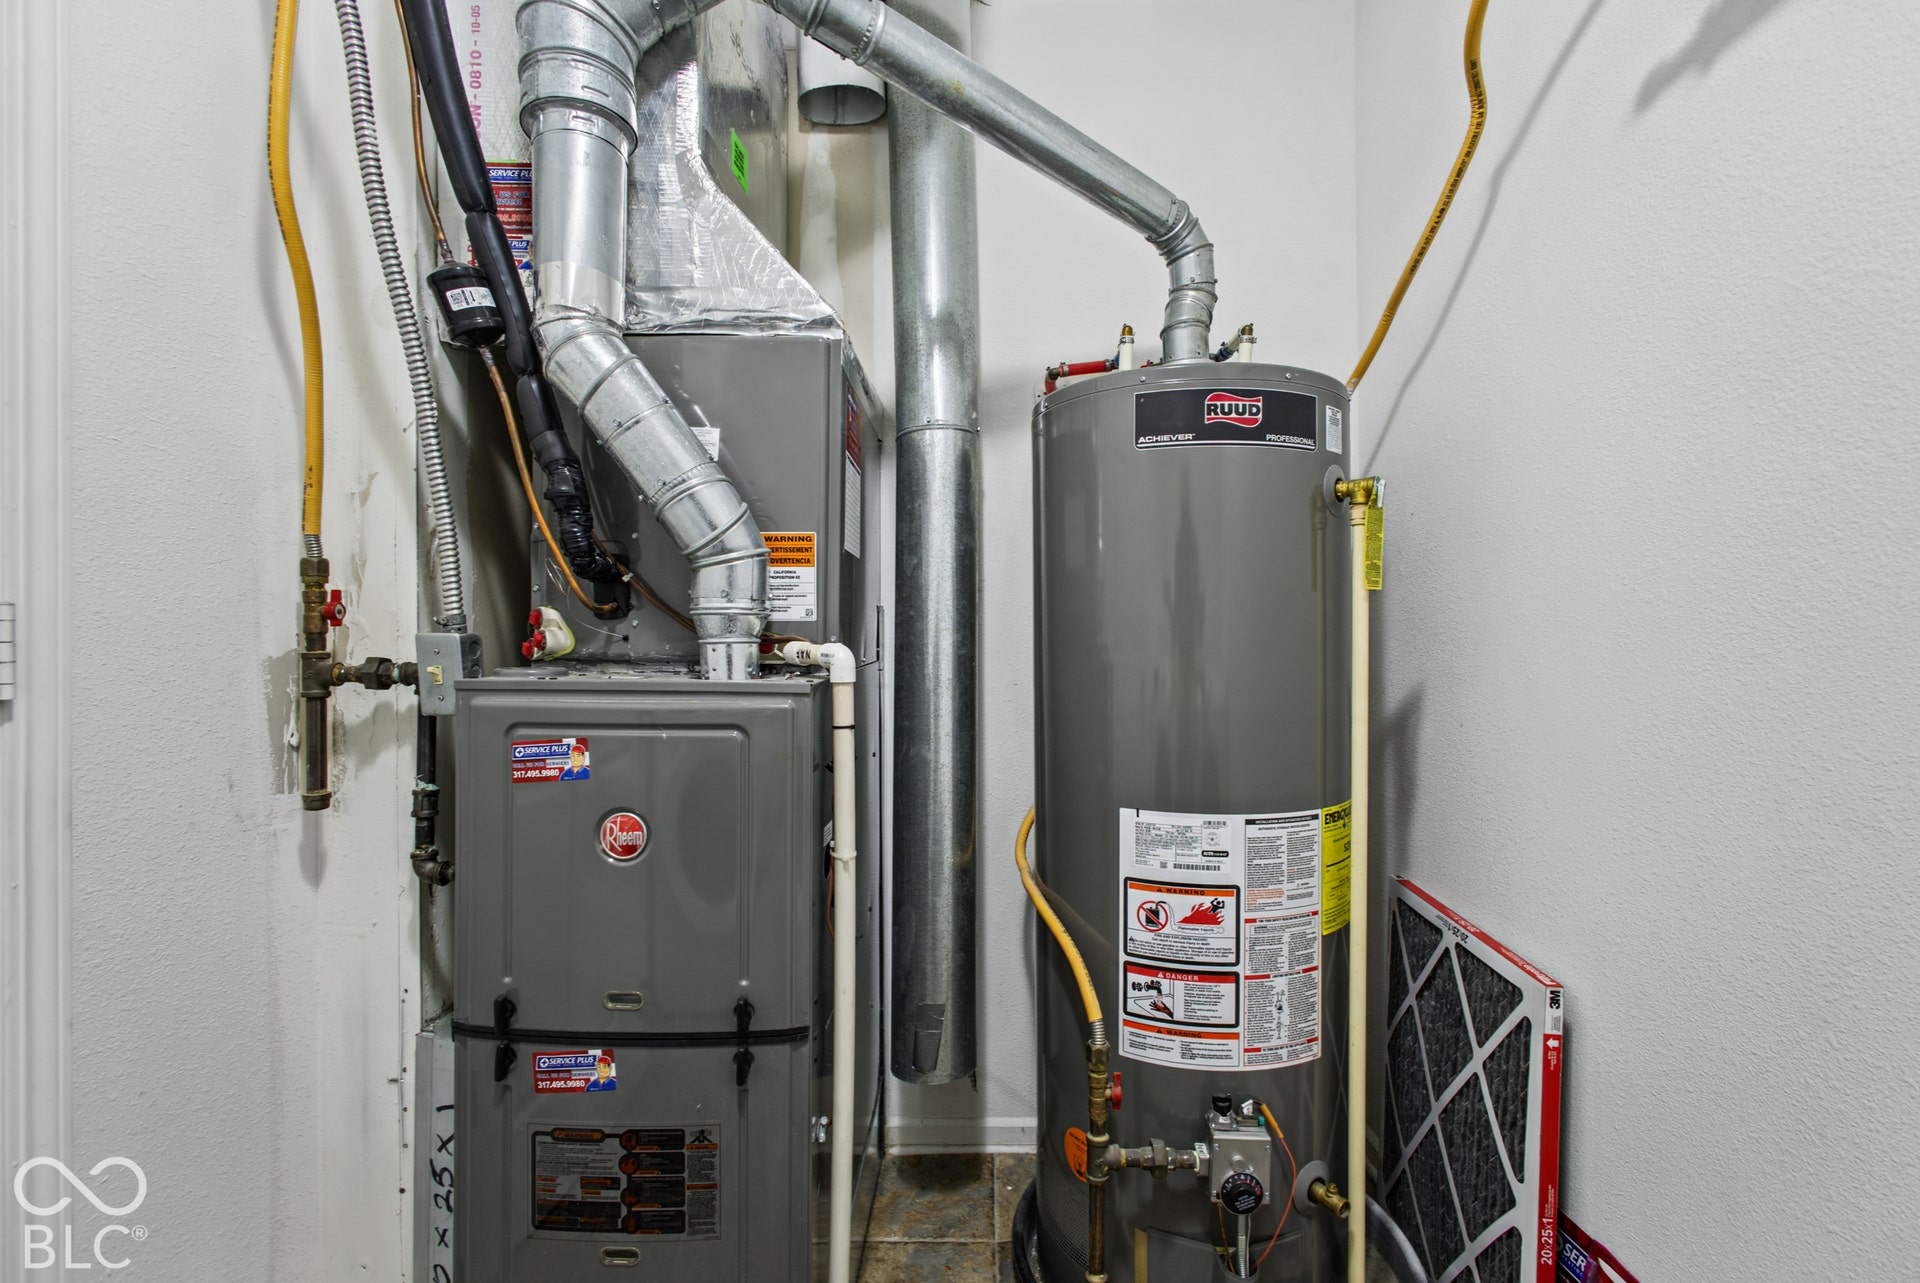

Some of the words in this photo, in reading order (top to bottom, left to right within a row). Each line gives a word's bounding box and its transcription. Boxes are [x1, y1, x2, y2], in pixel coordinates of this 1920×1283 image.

[471, 5, 481, 34] 10-05
[469, 50, 482, 89] 0810
[489, 169, 520, 177] SERVICE
[1206, 402, 1262, 416] RUUD
[1266, 434, 1315, 446] PROFESSIONAL
[764, 535, 812, 543] WARNING
[524, 746, 551, 754] SERVICE
[512, 769, 560, 778] 317.495.9980
[606, 816, 643, 851] Rheem
[1165, 887, 1206, 896] WARNING
[1165, 972, 1199, 981] DANGER
[1549, 990, 1561, 1010] 3M
[1166, 1029, 1202, 1038] WARNING
[549, 1057, 576, 1065] SERVICE
[537, 1080, 585, 1089] 317.495.9980
[430, 1158, 454, 1213] 25
[1541, 1218, 1554, 1265] 20x25x1
